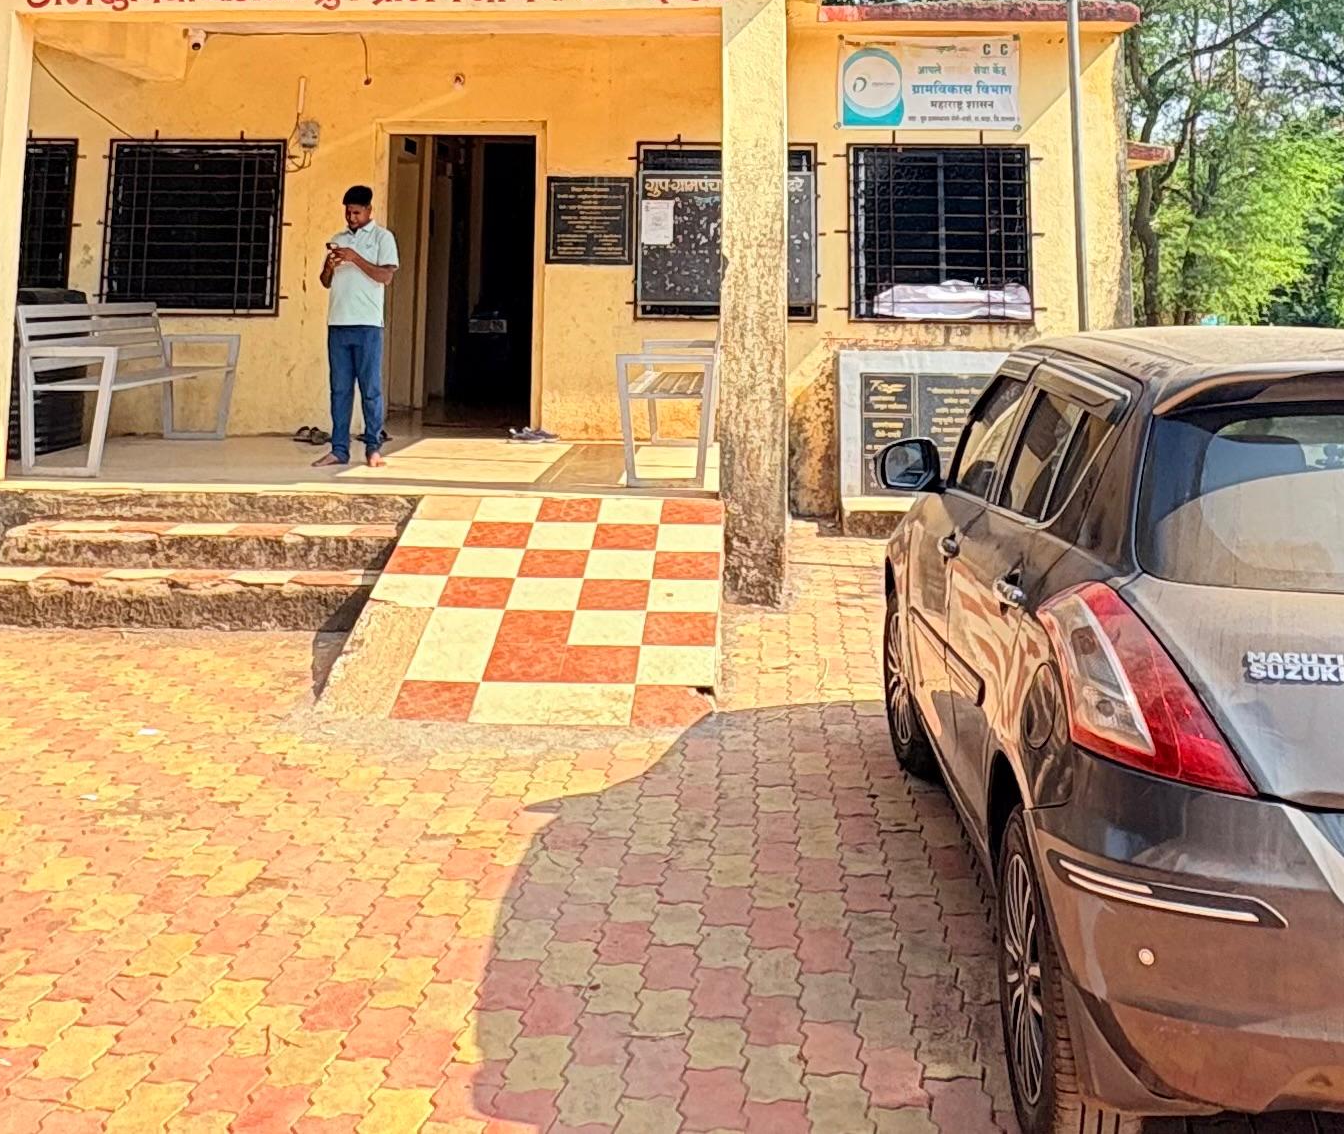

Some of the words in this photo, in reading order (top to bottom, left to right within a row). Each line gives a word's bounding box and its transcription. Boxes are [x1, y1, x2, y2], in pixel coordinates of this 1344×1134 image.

[911, 80, 973, 95] ग्रामविकास
[975, 80, 1012, 95] विभाग
[930, 100, 963, 112] महाराष्ट्र
[966, 100, 994, 110] शासन
[671, 175, 723, 193] ग्रामपंच
[1246, 650, 1344, 666] MARUTI
